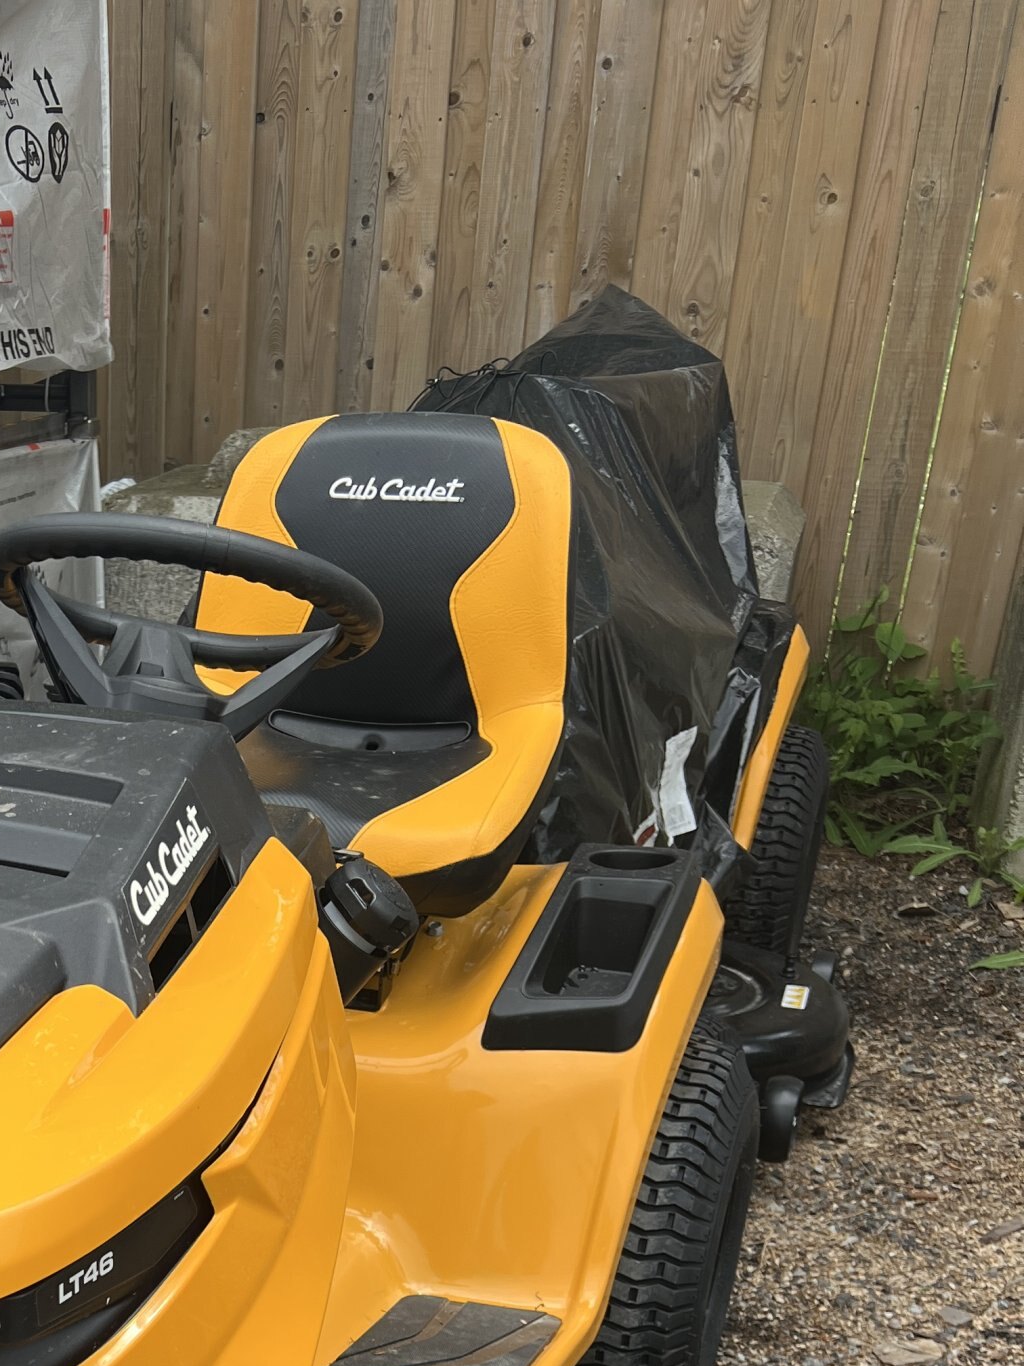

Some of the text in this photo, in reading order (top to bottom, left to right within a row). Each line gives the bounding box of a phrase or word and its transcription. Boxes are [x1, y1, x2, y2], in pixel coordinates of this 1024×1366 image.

[27, 327, 55, 356] END
[329, 476, 464, 502] Cub Cadet
[130, 805, 209, 926] Cub Cadet
[58, 1251, 114, 1304] LT46
